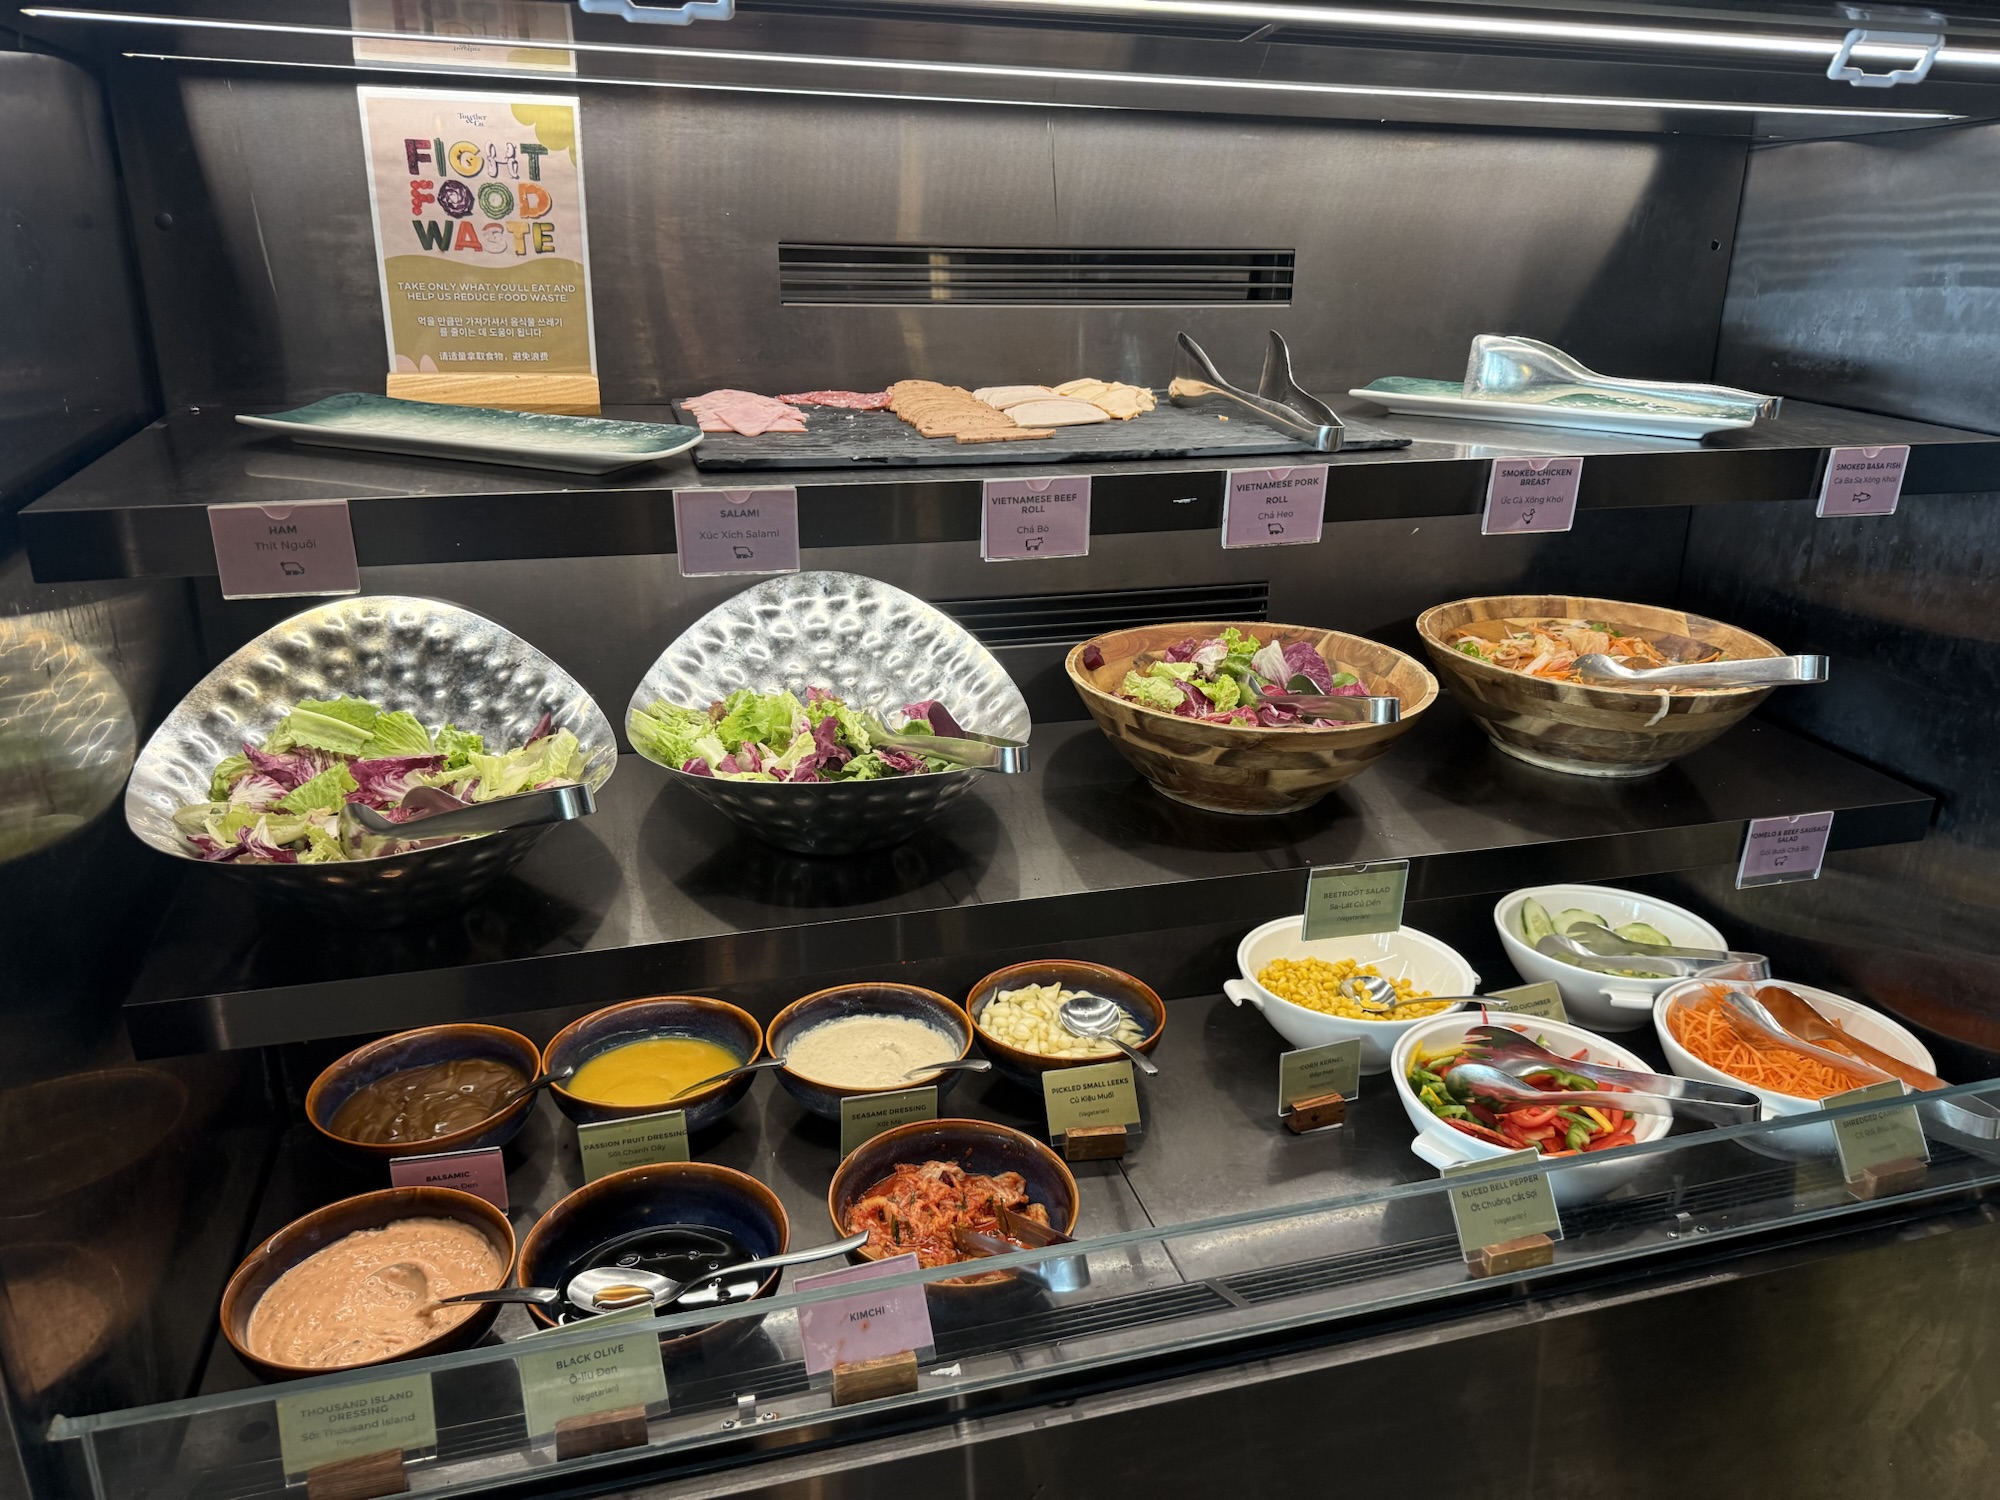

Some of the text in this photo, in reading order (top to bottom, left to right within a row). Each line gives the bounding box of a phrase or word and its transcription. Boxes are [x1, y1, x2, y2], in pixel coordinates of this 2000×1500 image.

[457, 112, 487, 121] Together
[404, 137, 548, 181] FIGHT
[409, 179, 553, 220] FOOD
[412, 220, 555, 256] WASTE
[398, 282, 576, 293] TAKE ONLY WHAT YOU'LL EAT AND
[407, 292, 568, 303] HELP US REDUCE FOOD WASTE.
[417, 316, 435, 327] 먹을
[437, 317, 463, 327] 만큼만
[510, 317, 535, 327] 음식물
[537, 317, 563, 327] 쓰레기
[440, 328, 448, 337] 를
[450, 328, 476, 337] 줄이는
[489, 328, 514, 338] 도움이
[1836, 463, 1865, 471] SMOKED
[1866, 462, 1885, 470] BASA
[1537, 469, 1572, 477] CHICKEN
[1236, 477, 1319, 492] VIETNAMESE PORK
[1520, 478, 1551, 486] BREAST
[992, 493, 1078, 505] VIETNAMESE BEEF
[1266, 496, 1288, 504] ROLL
[720, 509, 760, 518] SALAMI
[1022, 505, 1045, 514] ROLL
[1276, 510, 1294, 518] Heo
[269, 525, 298, 535] HAM
[720, 530, 744, 539] Xích
[746, 529, 780, 538] Salami
[1783, 828, 1799, 836] BEEF
[1777, 836, 1798, 844] SALAD
[1323, 886, 1391, 900] BEETROOT SALAD
[1519, 998, 1551, 1010] CUCUMBER
[1300, 1056, 1344, 1070] CORN KERNEL
[1052, 1078, 1129, 1094] PICKLED SMALL LEEKS
[851, 1104, 927, 1120] SEASAME DRESSING
[584, 1140, 620, 1151] PASSION
[622, 1136, 646, 1145] FRUIT
[622, 1146, 649, 1156] Chanh
[426, 1171, 471, 1182] BALSAMIC
[1461, 1174, 1539, 1199] SLICED BELL PEPPER
[849, 1306, 885, 1322] KIMCHI
[556, 1344, 625, 1370] BLACK OLIVE
[596, 1365, 618, 1377] Đen
[572, 1384, 620, 1404] (Vegetarian)
[300, 1390, 414, 1418] THOUSAND ISLAND
[328, 1404, 389, 1423] DRESSING
[323, 1419, 379, 1438] Thousand
[382, 1413, 416, 1427] Island
